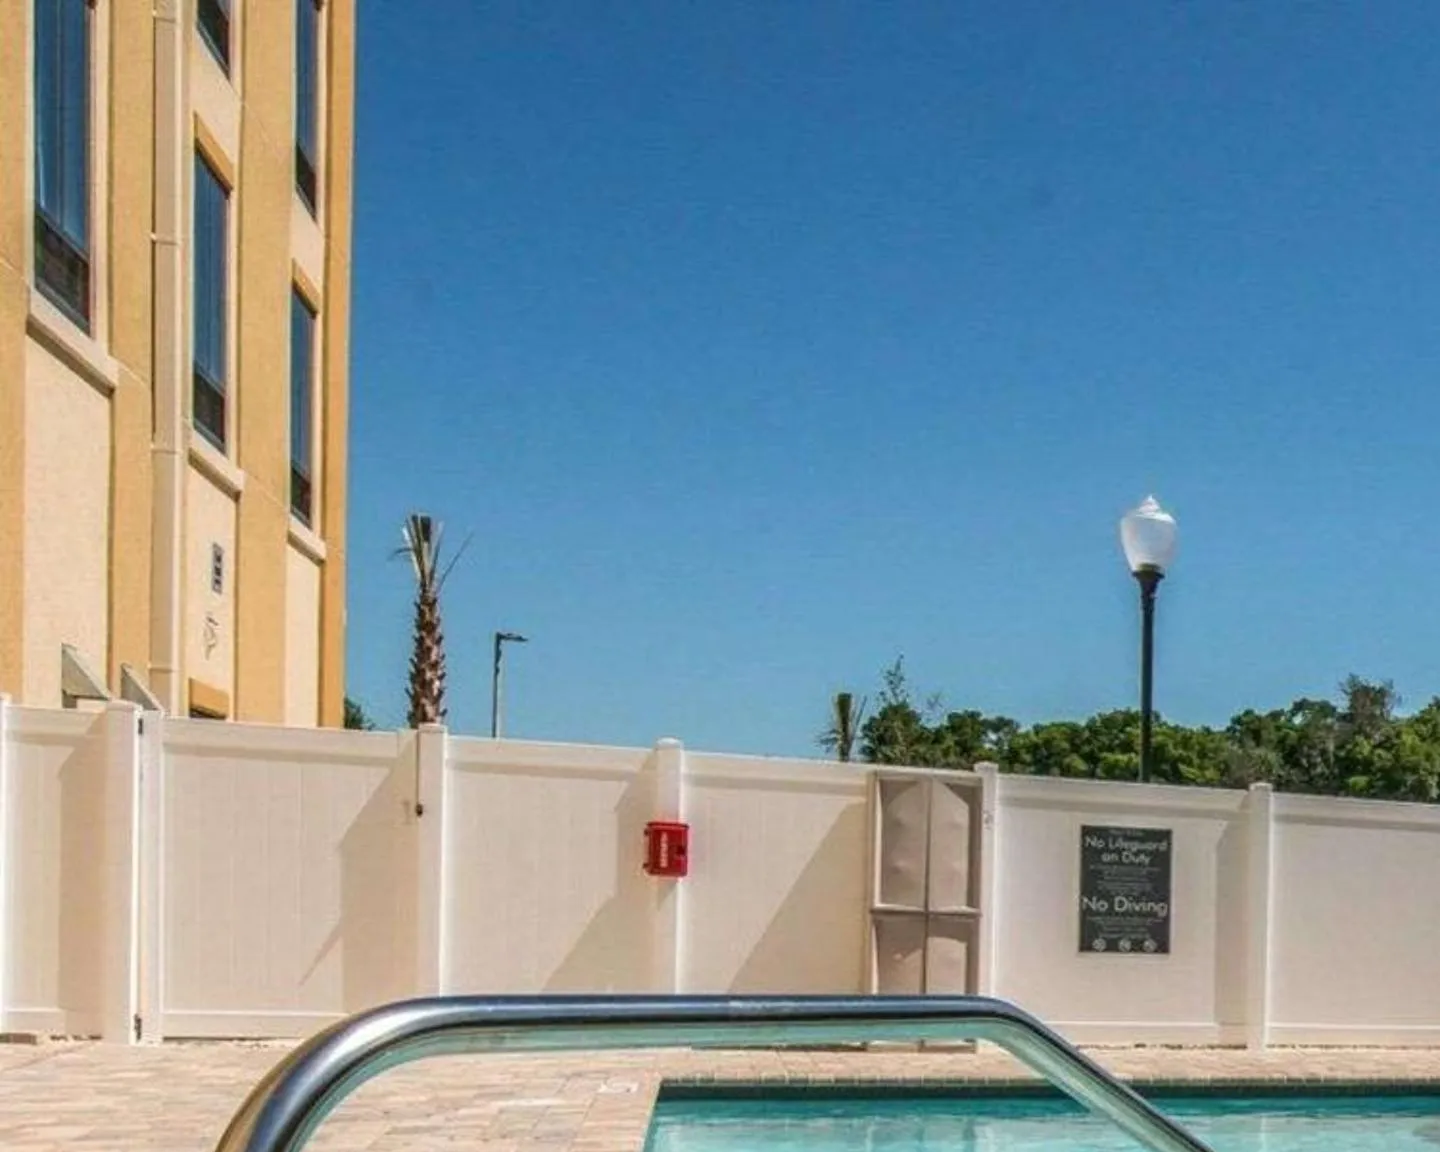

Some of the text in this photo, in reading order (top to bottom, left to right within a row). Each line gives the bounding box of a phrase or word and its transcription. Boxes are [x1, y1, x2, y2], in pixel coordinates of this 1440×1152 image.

[1084, 835, 1105, 849] No
[1081, 895, 1168, 917] No Diving
